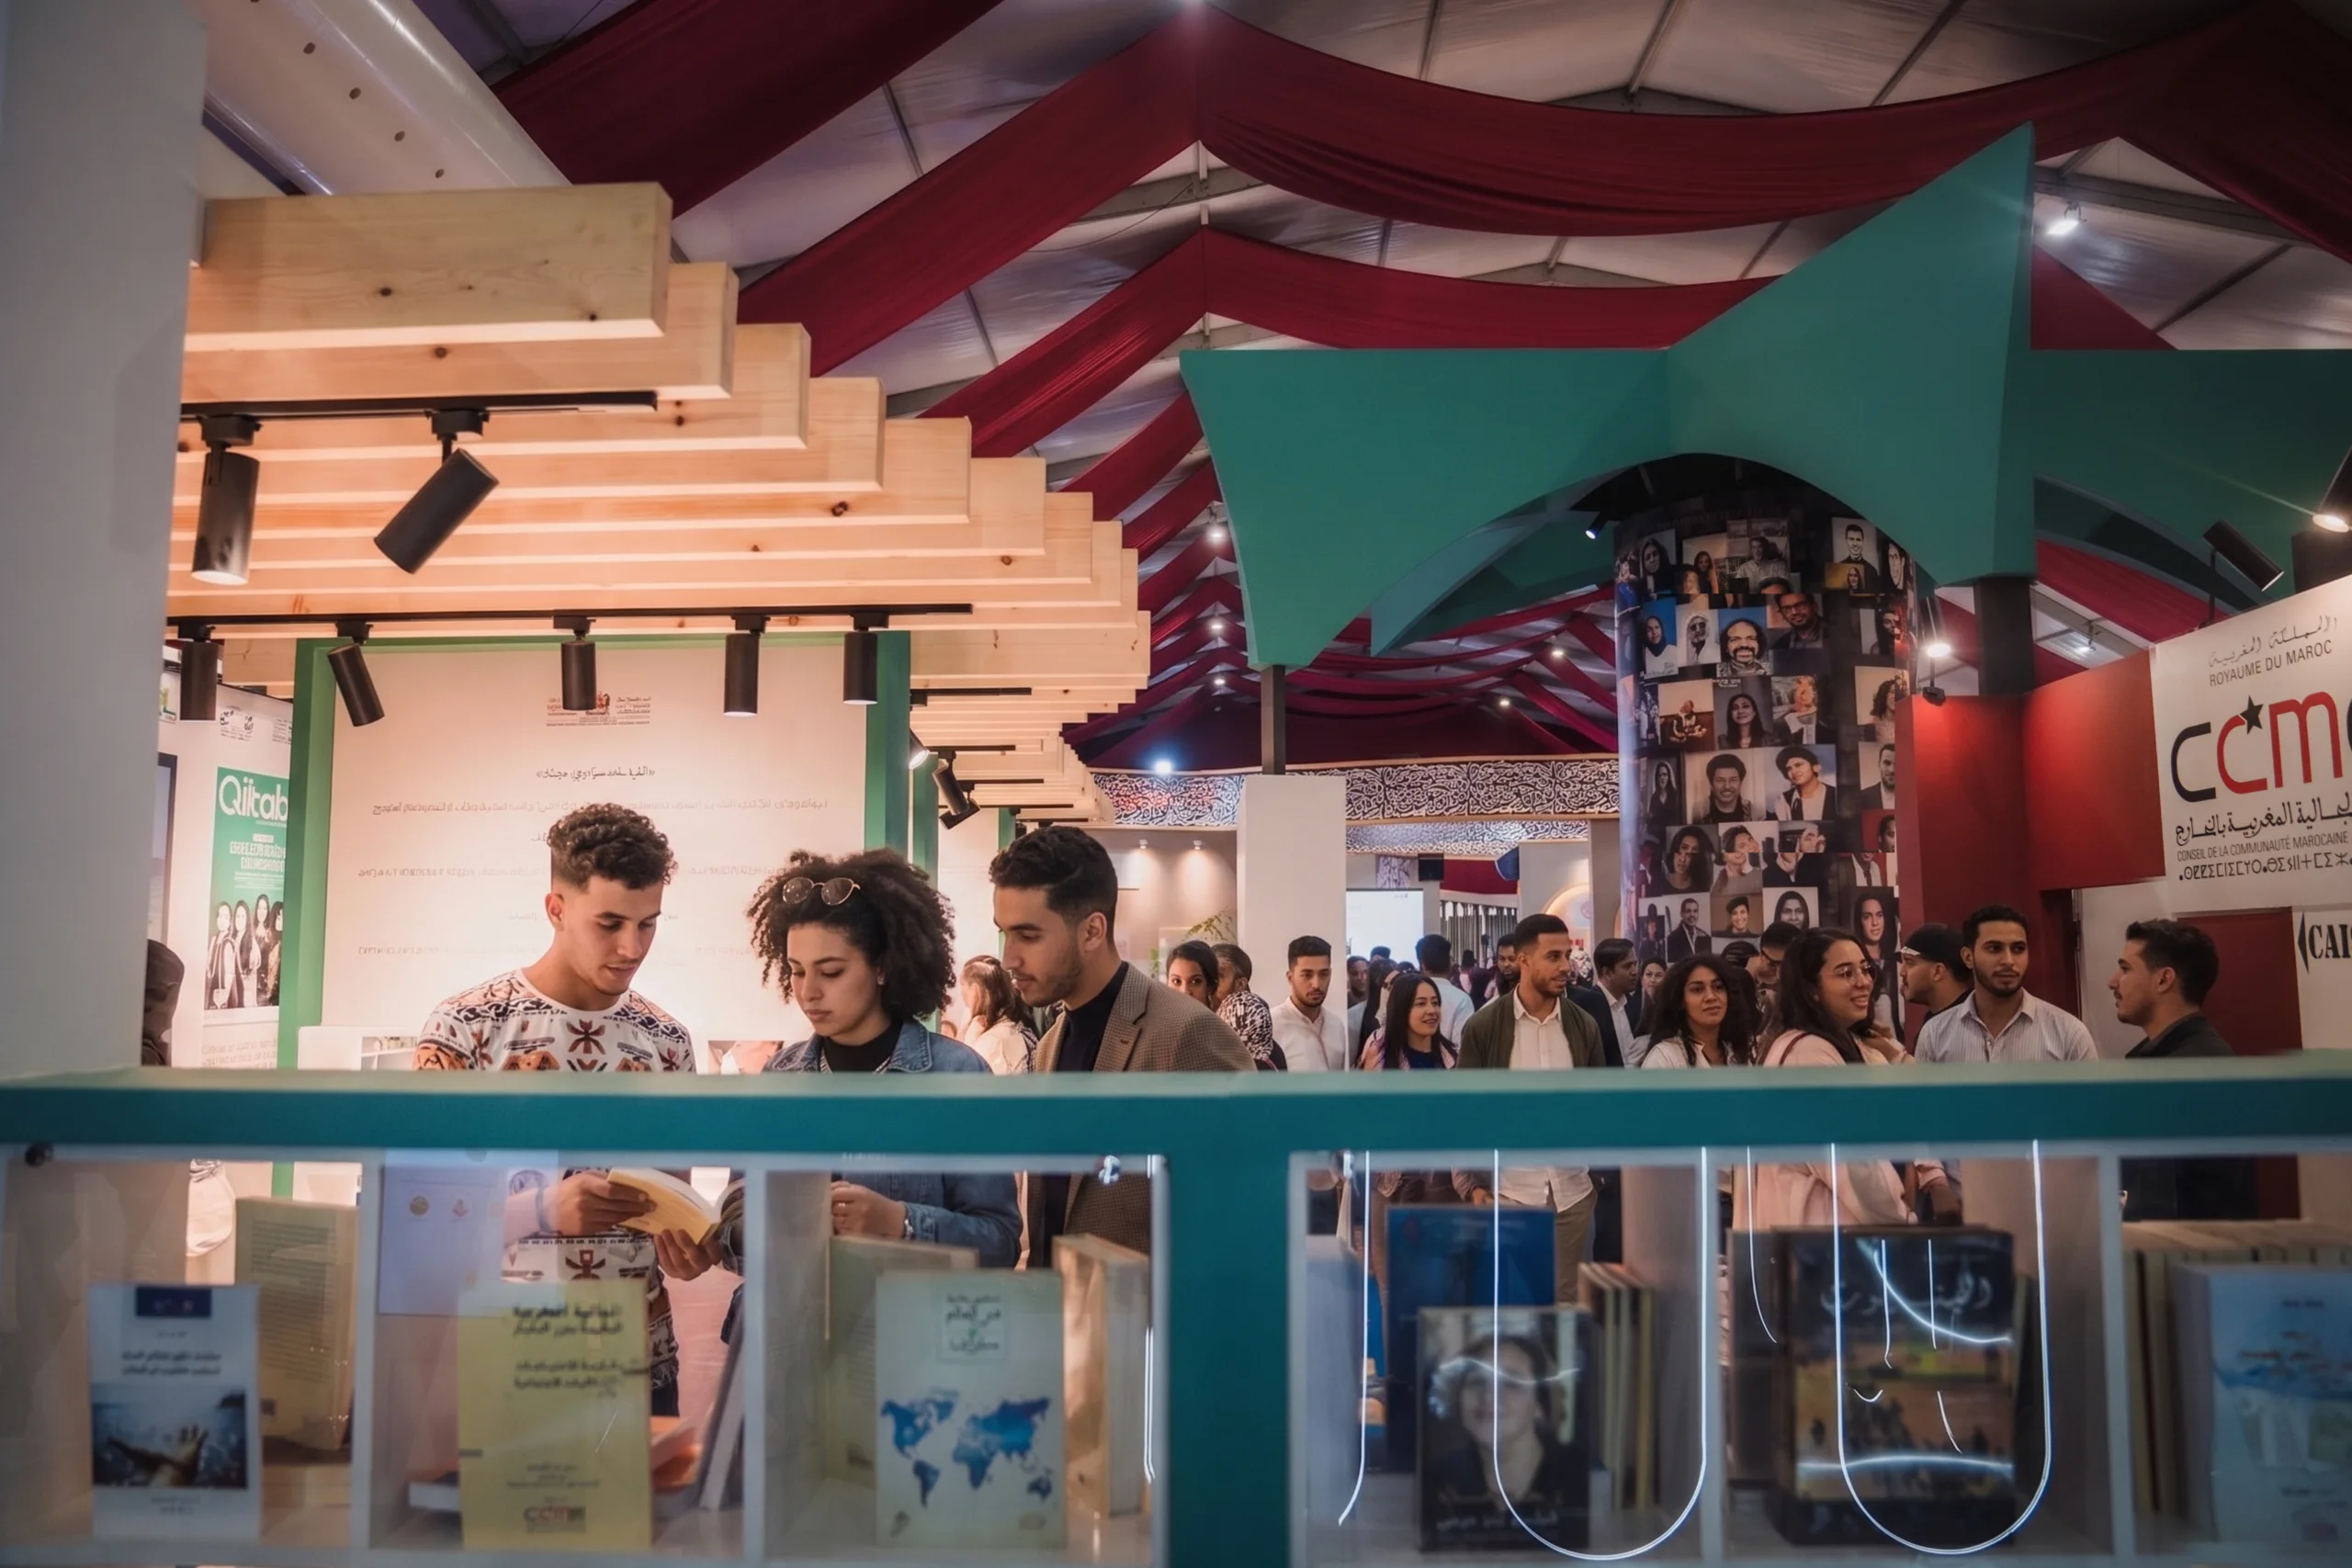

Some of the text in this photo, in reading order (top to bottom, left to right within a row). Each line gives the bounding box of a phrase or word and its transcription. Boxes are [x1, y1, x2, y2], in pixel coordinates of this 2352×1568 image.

[2210, 639, 2333, 688] ROYAUME DU MAROC
[2176, 814, 2226, 846] بالخارج
[2227, 801, 2293, 838] المغربية
[2177, 831, 2349, 862] CONSEIL DE LA COMMUNAUTÉ MAROCAINE
[2308, 924, 2352, 959] CAI
